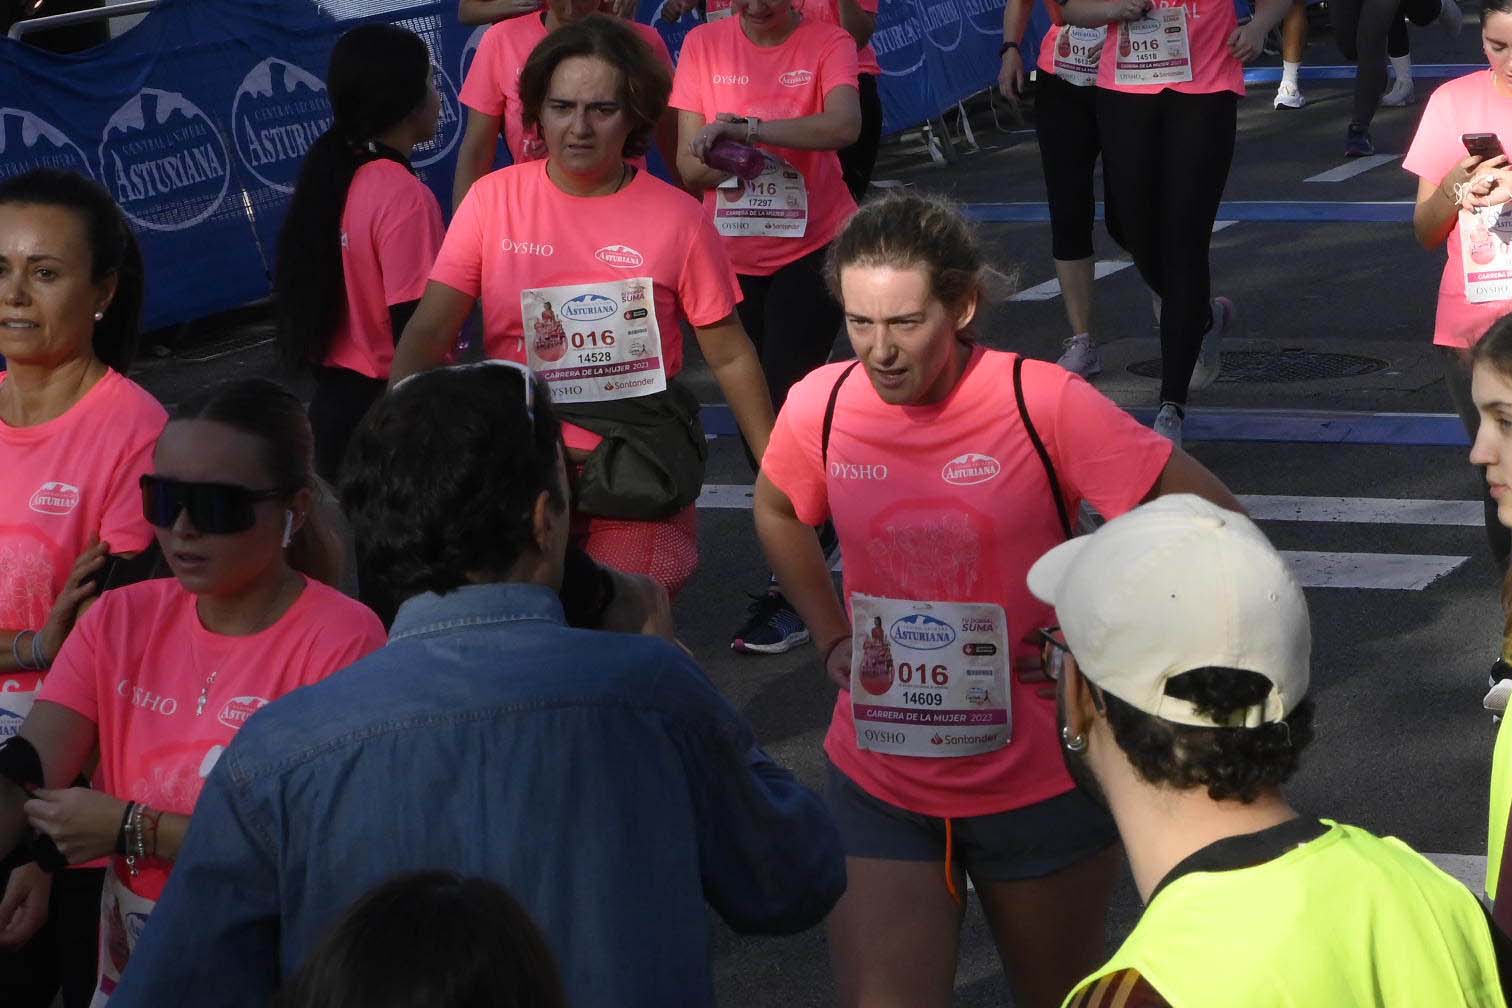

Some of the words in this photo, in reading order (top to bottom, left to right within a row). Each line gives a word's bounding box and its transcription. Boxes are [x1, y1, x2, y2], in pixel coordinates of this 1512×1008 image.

[1132, 39, 1160, 52] 016
[713, 74, 750, 86] OYSHO
[110, 142, 224, 203] ASTURIANA
[748, 198, 773, 207] 17297
[501, 238, 554, 257] OYSHO
[600, 251, 641, 265] ASTURIANA
[621, 293, 645, 303] SUMA
[564, 304, 615, 318] ASTURIANA
[571, 329, 616, 349] 016
[578, 351, 612, 364] 14528
[544, 368, 581, 381] CARRERA
[581, 367, 593, 377] DE
[593, 366, 604, 376] LA
[604, 364, 630, 375] MUJER
[614, 377, 656, 391] Santander
[830, 462, 889, 480] OYSHO
[946, 463, 997, 480] ASTURIANA
[892, 626, 950, 643] ASTURIANA
[961, 623, 994, 633] SUMA
[898, 662, 949, 686] 016
[902, 692, 943, 706] 14609
[866, 709, 902, 720] CARRERA
[904, 711, 917, 721] DE
[919, 712, 932, 722] LA
[933, 713, 967, 724] MUJER
[970, 712, 993, 723] 2023
[864, 728, 905, 745] OYSHO
[944, 731, 999, 746] Santander
